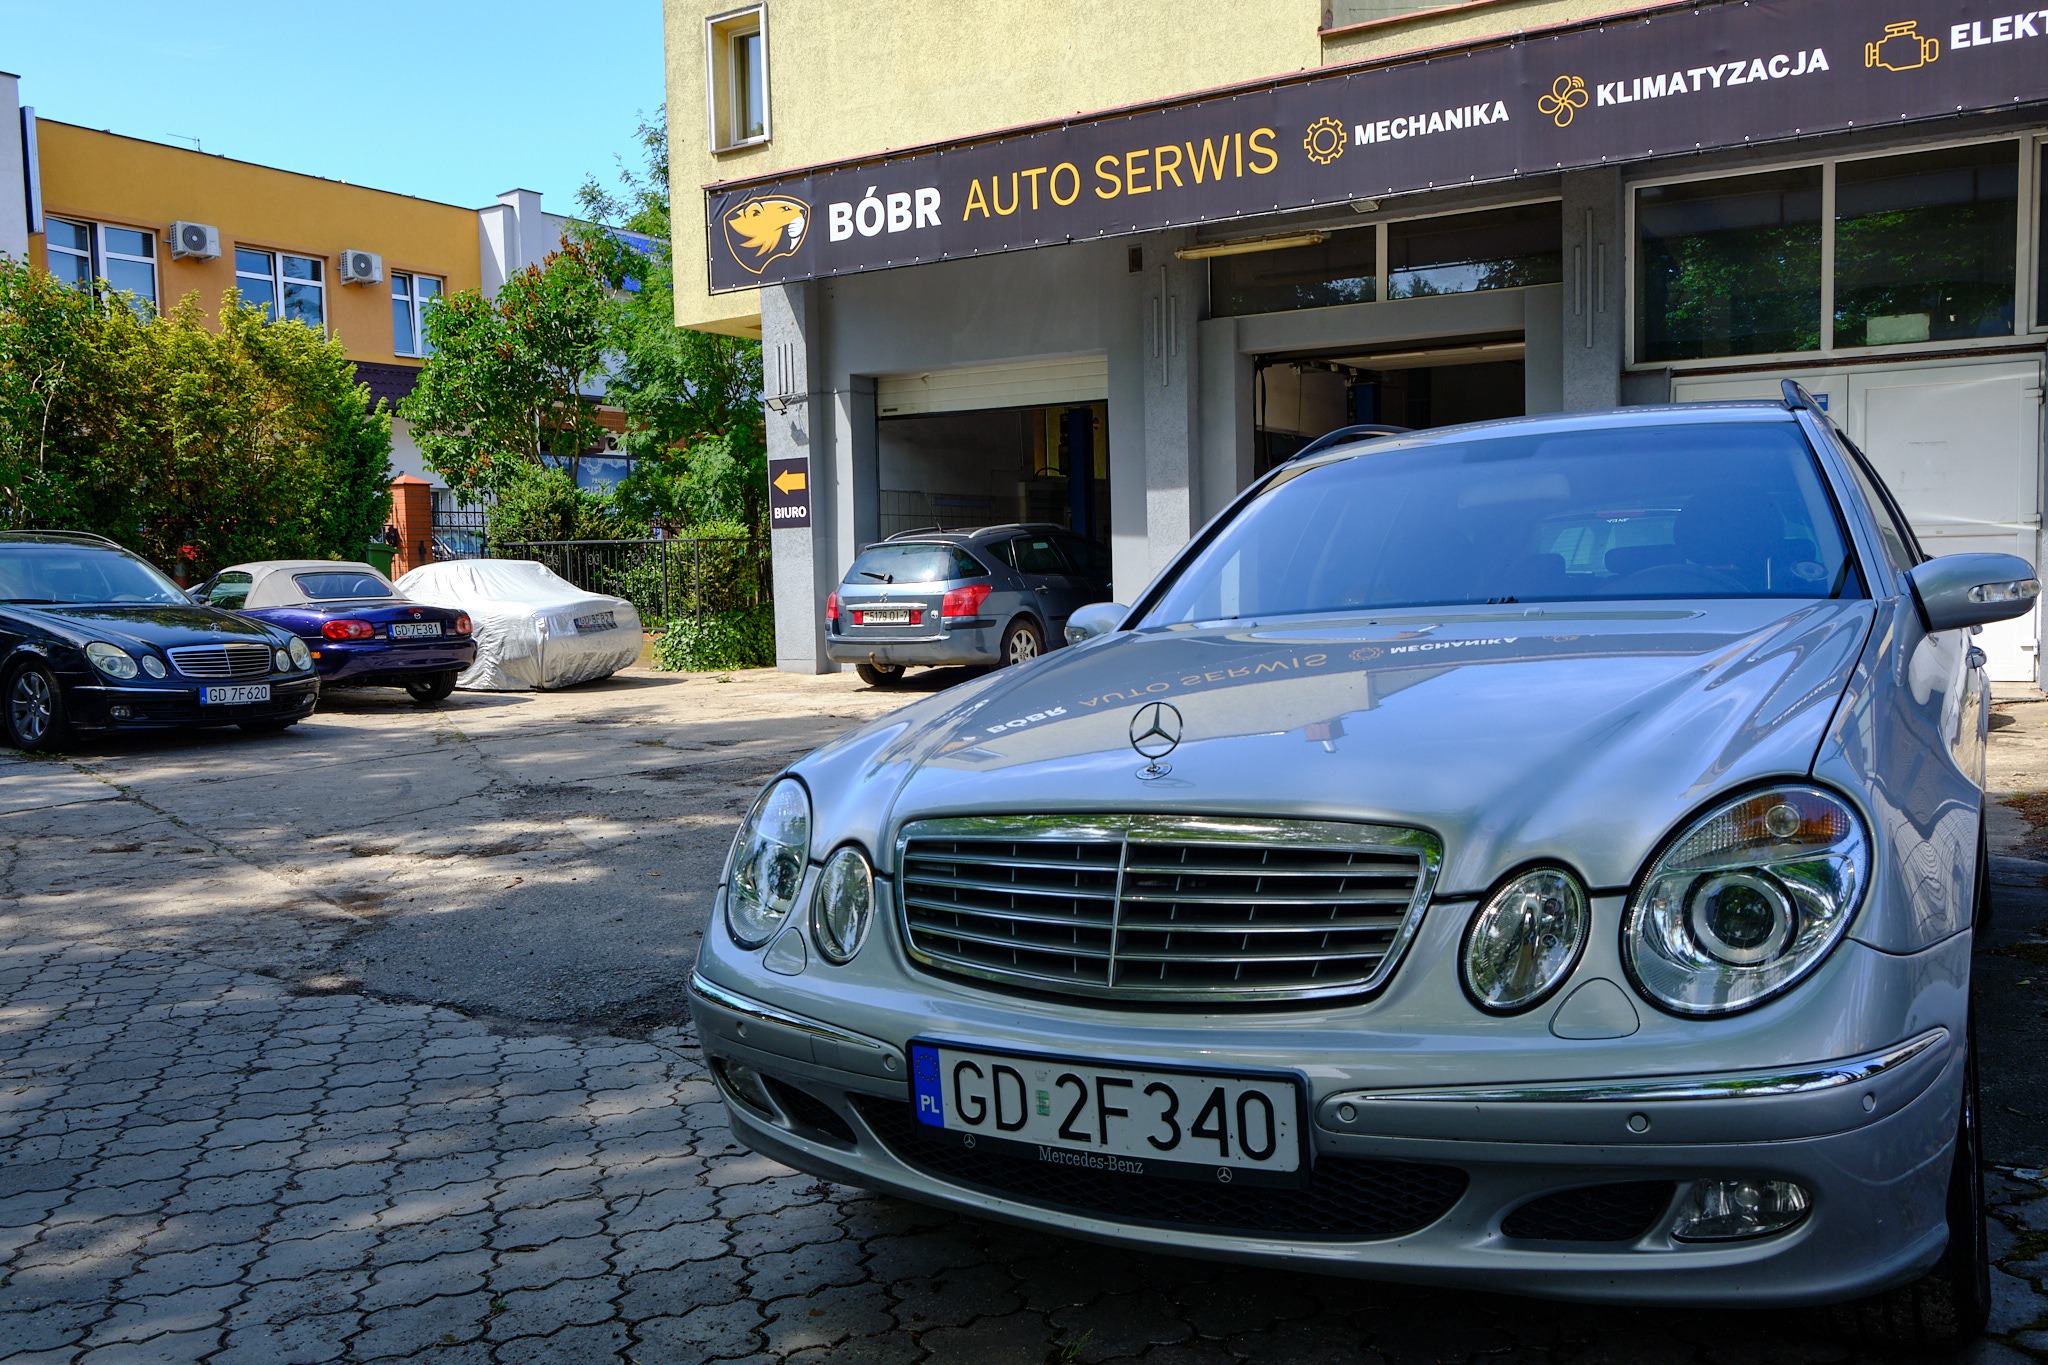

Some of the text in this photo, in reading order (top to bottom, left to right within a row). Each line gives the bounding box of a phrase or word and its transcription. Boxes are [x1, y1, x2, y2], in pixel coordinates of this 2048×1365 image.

[1596, 47, 1830, 107] KLIMATYZACJA
[1354, 100, 1510, 146] MECHANIKA
[828, 127, 1279, 243] BÓBR AUTO SERWIS
[774, 505, 807, 519] BIURO
[394, 624, 408, 636] GD
[410, 623, 439, 635] 7E381
[209, 686, 268, 702] GD 7F620
[920, 1094, 940, 1114] PL
[953, 1060, 1277, 1162] GD 2F340
[1038, 1145, 1144, 1175] Mercedes-Benz
